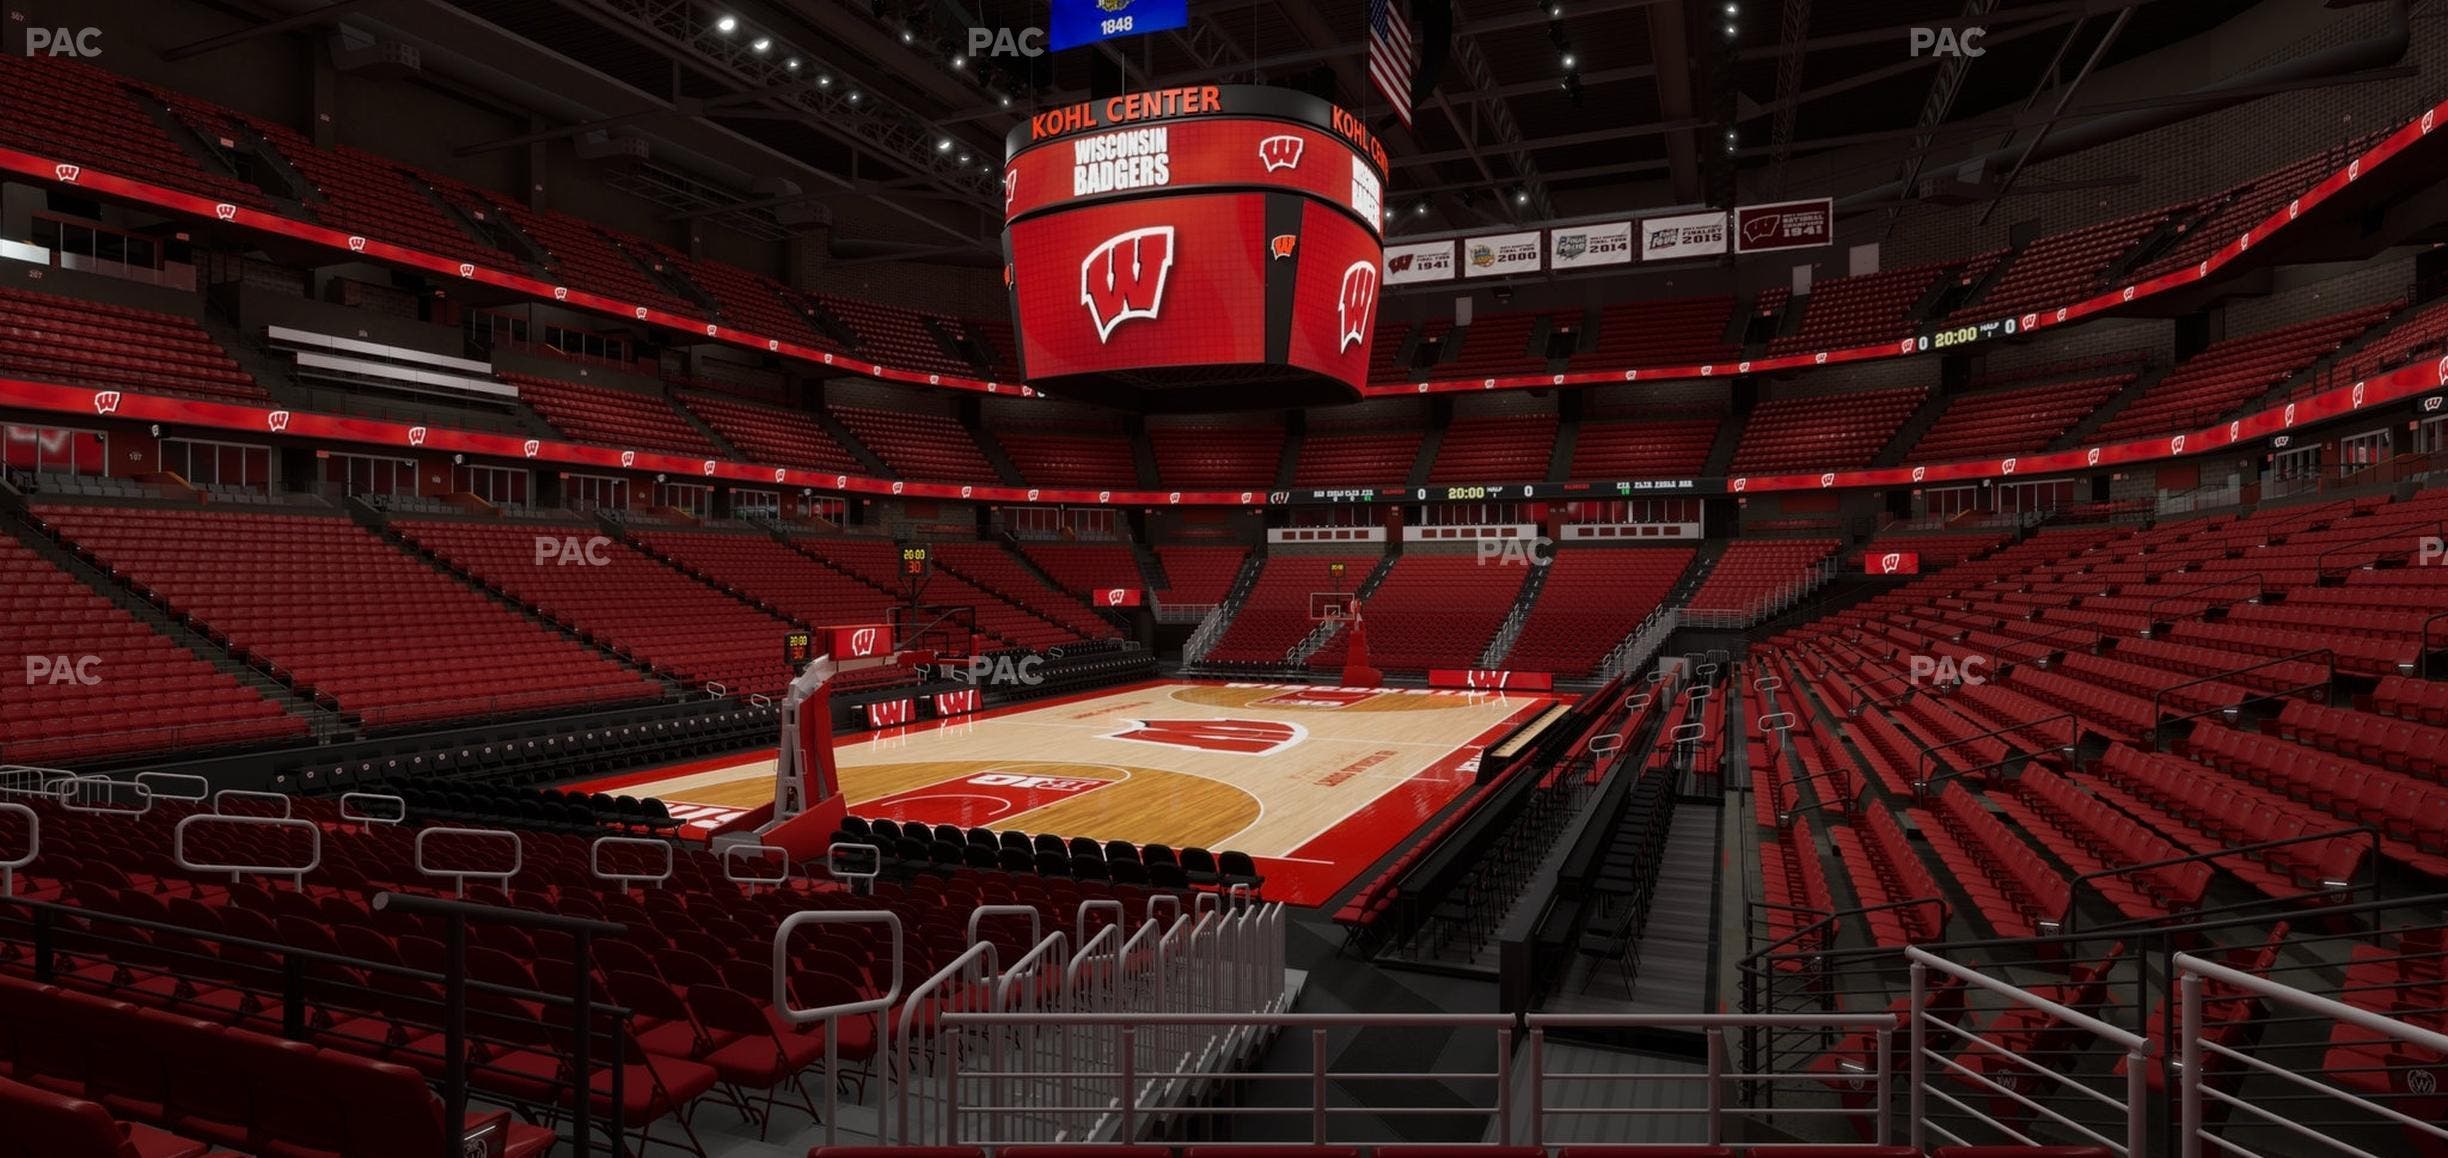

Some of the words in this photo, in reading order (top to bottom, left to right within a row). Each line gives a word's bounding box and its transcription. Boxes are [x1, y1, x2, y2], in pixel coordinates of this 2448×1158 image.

[1100, 15, 1133, 36] 1848
[1031, 107, 1097, 140] KOHL
[1106, 86, 1221, 123] CENTER
[1333, 104, 1369, 152] KOHL
[1074, 127, 1168, 165] WISCONSIN
[1259, 135, 1303, 172] W
[1074, 154, 1169, 196] BADGERS
[1682, 233, 1722, 244] 2015
[1783, 225, 1823, 237] 1941
[1590, 242, 1627, 253] 2014
[1497, 252, 1537, 263] 2000
[1417, 261, 1449, 271] 1941
[1081, 226, 1174, 345] W
[2004, 319, 2016, 335] 0
[1919, 337, 1928, 351] 0
[1935, 327, 1978, 348] 20:00
[1417, 488, 1426, 501] 0
[1448, 486, 1485, 500] 20:00
[1524, 485, 1533, 498] 0
[903, 549, 925, 560] 20:00
